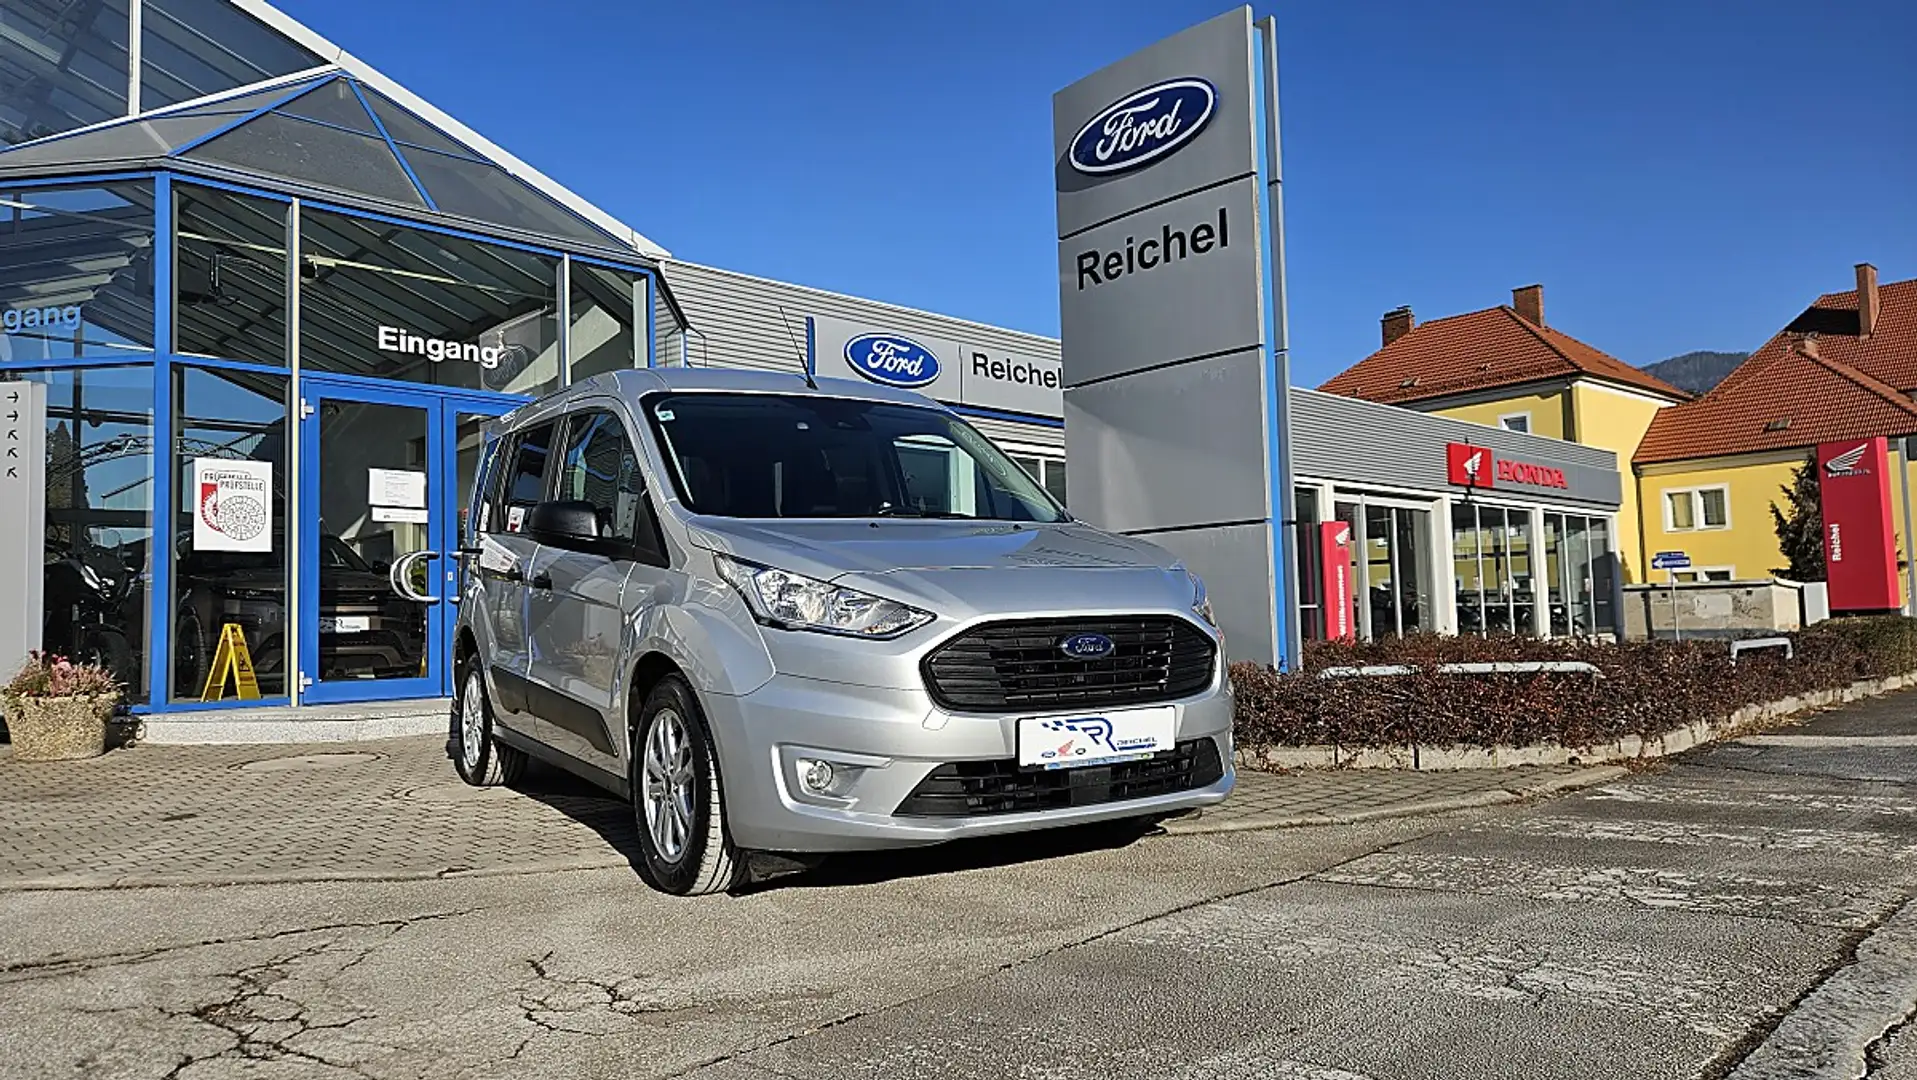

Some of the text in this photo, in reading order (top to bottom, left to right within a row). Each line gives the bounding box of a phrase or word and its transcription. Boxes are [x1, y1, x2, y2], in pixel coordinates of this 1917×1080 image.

[1095, 97, 1182, 161] Ford
[1076, 207, 1228, 291] Reichel
[378, 325, 500, 369] Eingang
[867, 340, 1062, 390] Ford Reichel
[1496, 459, 1568, 489] HONDA
[1829, 523, 1842, 561] Reichel
[1075, 637, 1104, 653] Ford
